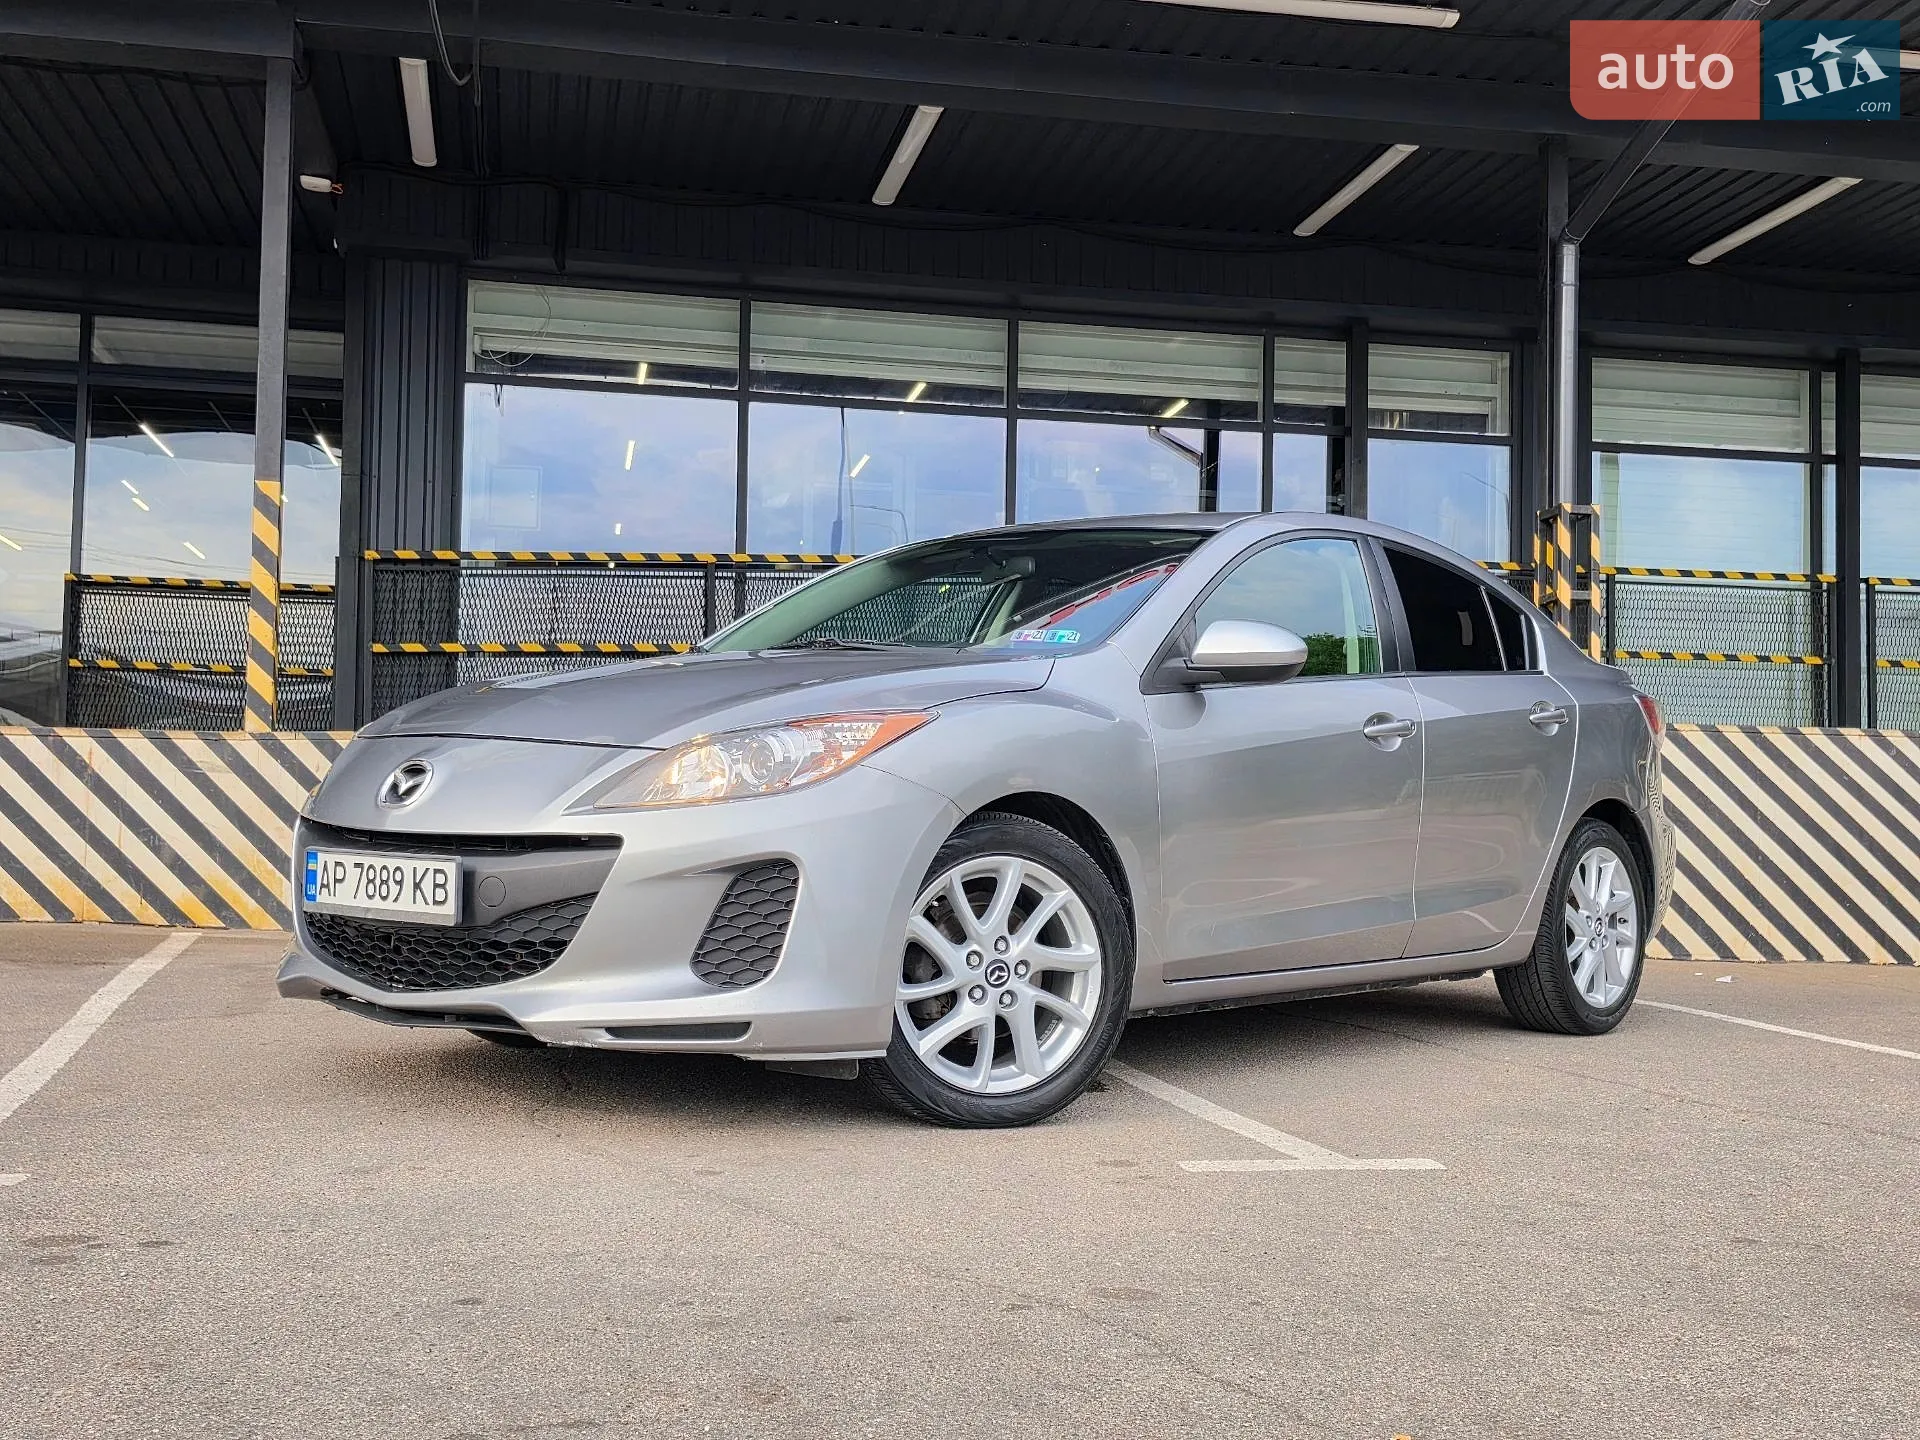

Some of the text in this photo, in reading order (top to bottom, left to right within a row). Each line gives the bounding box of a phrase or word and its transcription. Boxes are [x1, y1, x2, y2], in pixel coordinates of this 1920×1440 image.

[319, 860, 449, 906] AP 7889 KB
